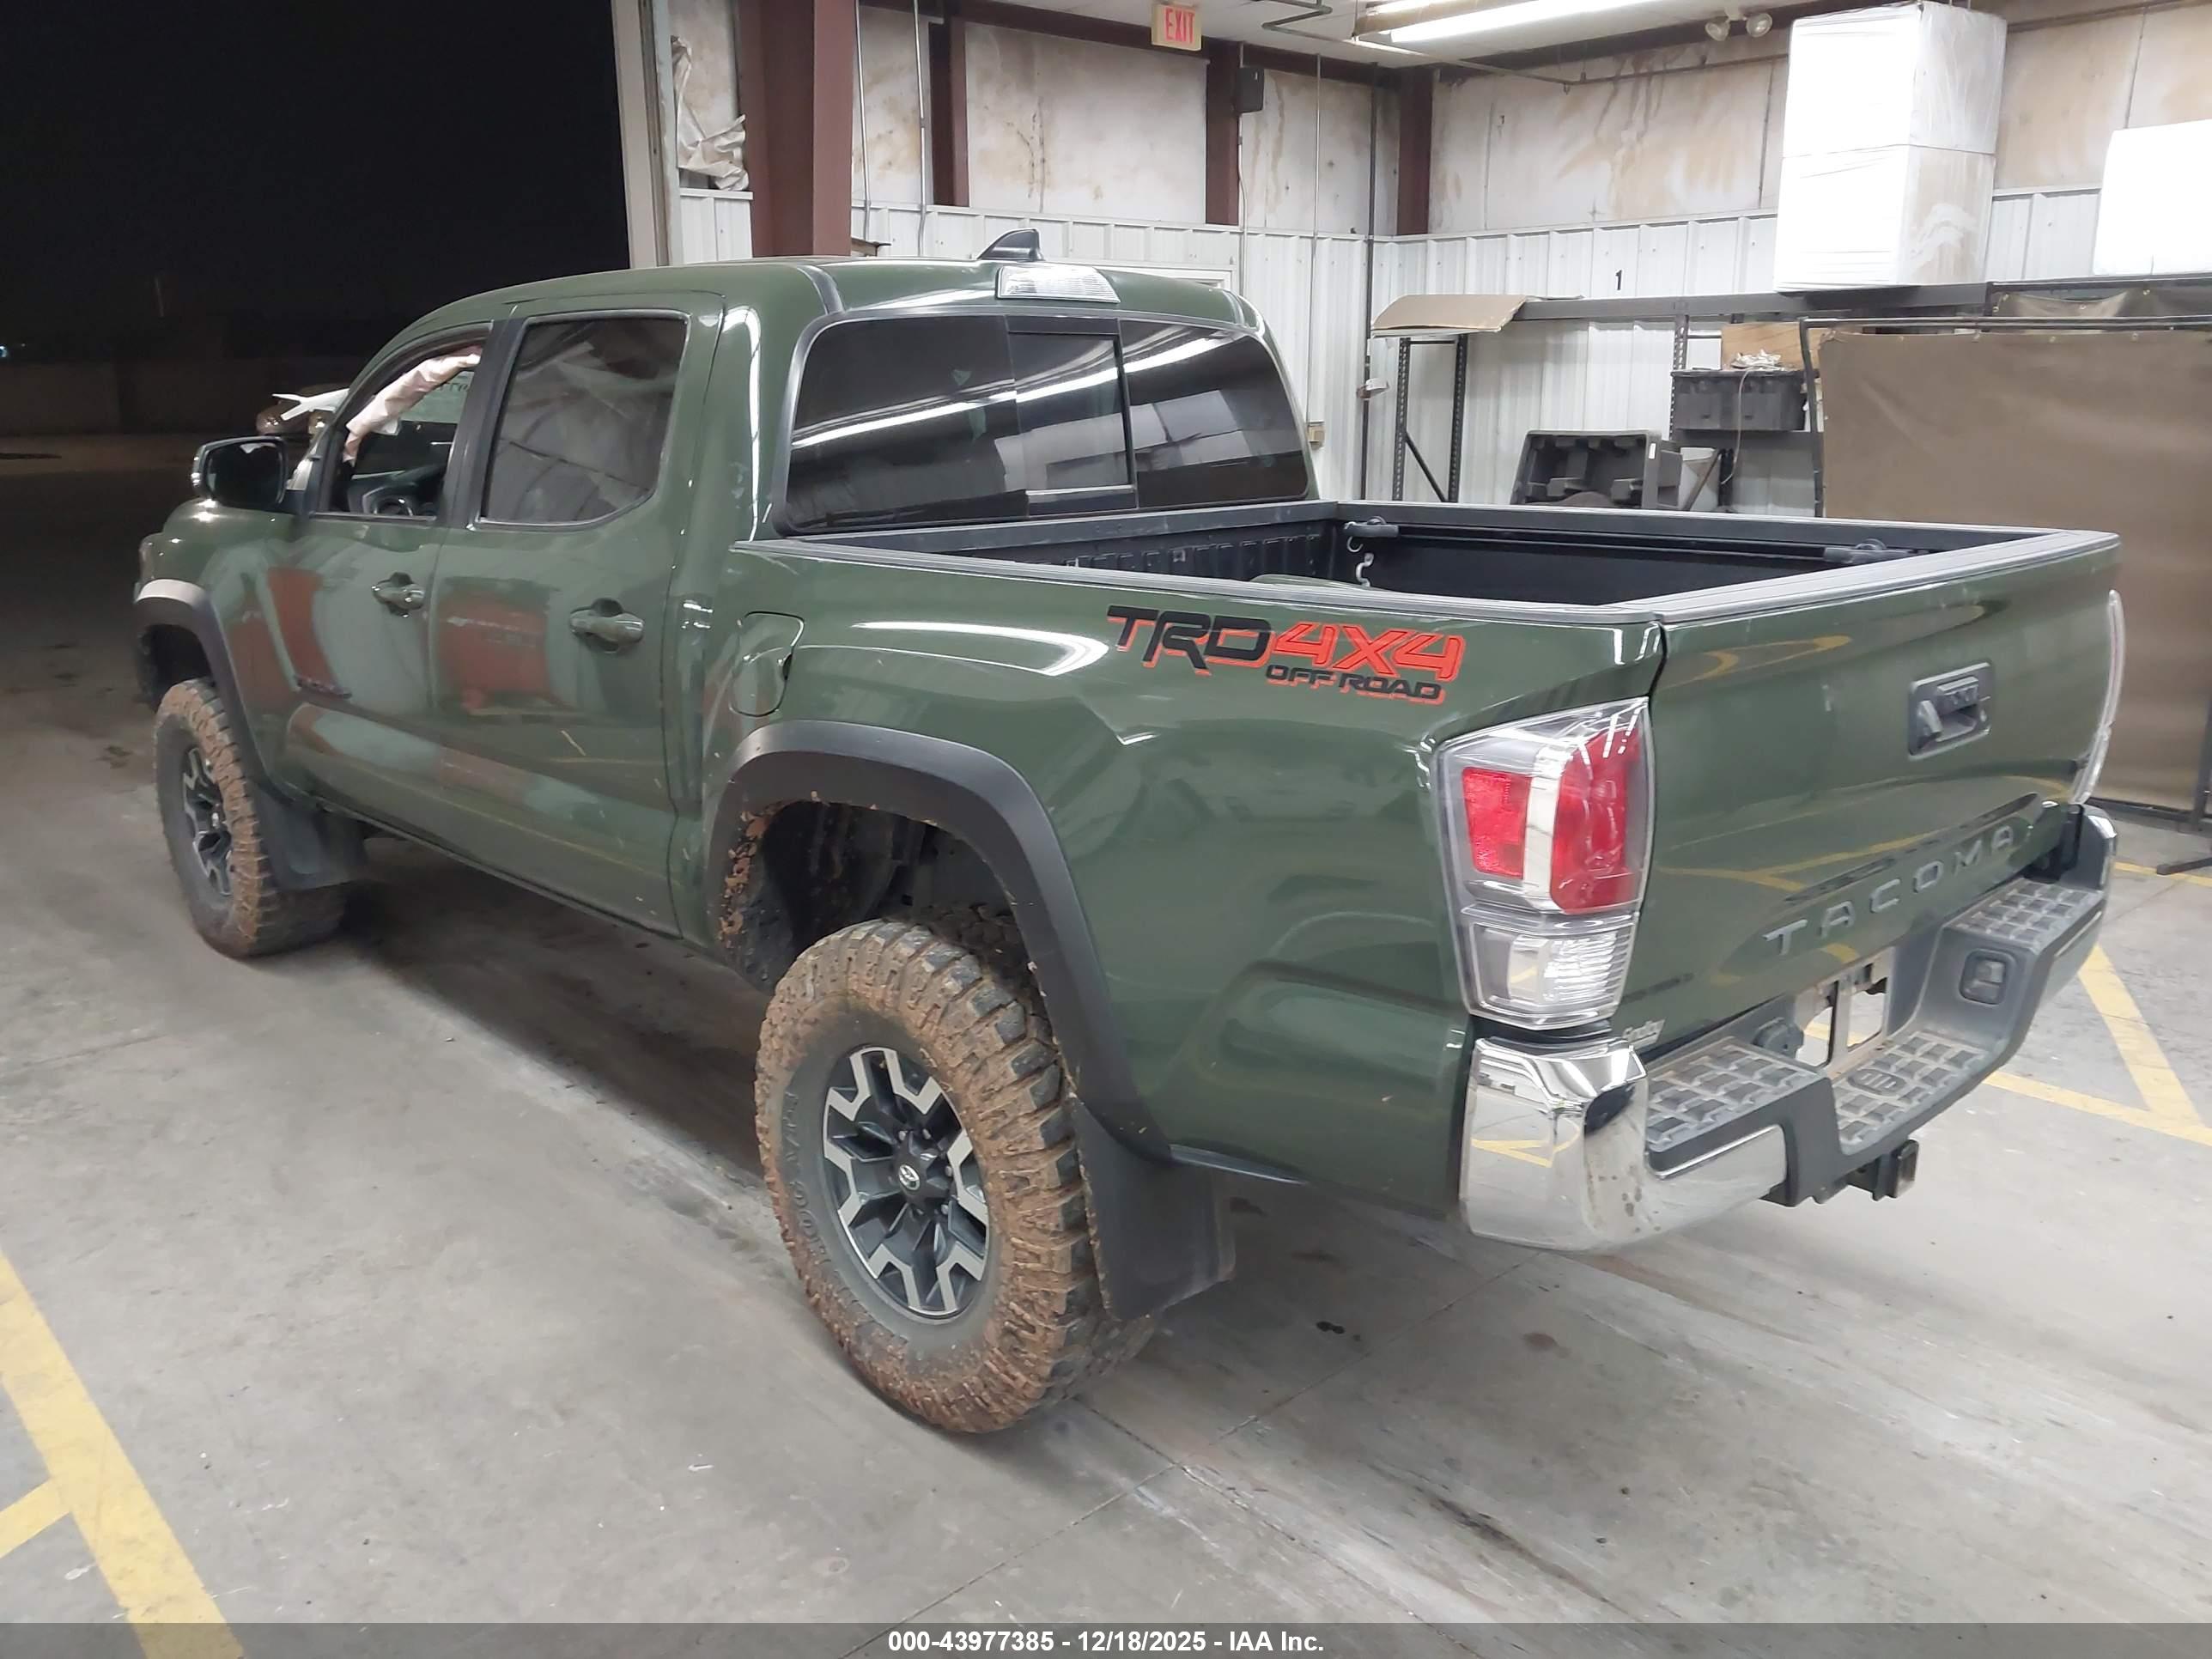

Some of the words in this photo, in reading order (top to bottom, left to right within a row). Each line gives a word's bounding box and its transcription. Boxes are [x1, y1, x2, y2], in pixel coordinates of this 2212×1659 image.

[1165, 7, 1195, 44] EXIT
[1615, 269, 1622, 290] 1
[1107, 605, 1276, 676] TRD
[1265, 664, 1336, 690] OFF
[1338, 672, 1446, 706] ROAD
[1762, 824, 2014, 956] TACOMA
